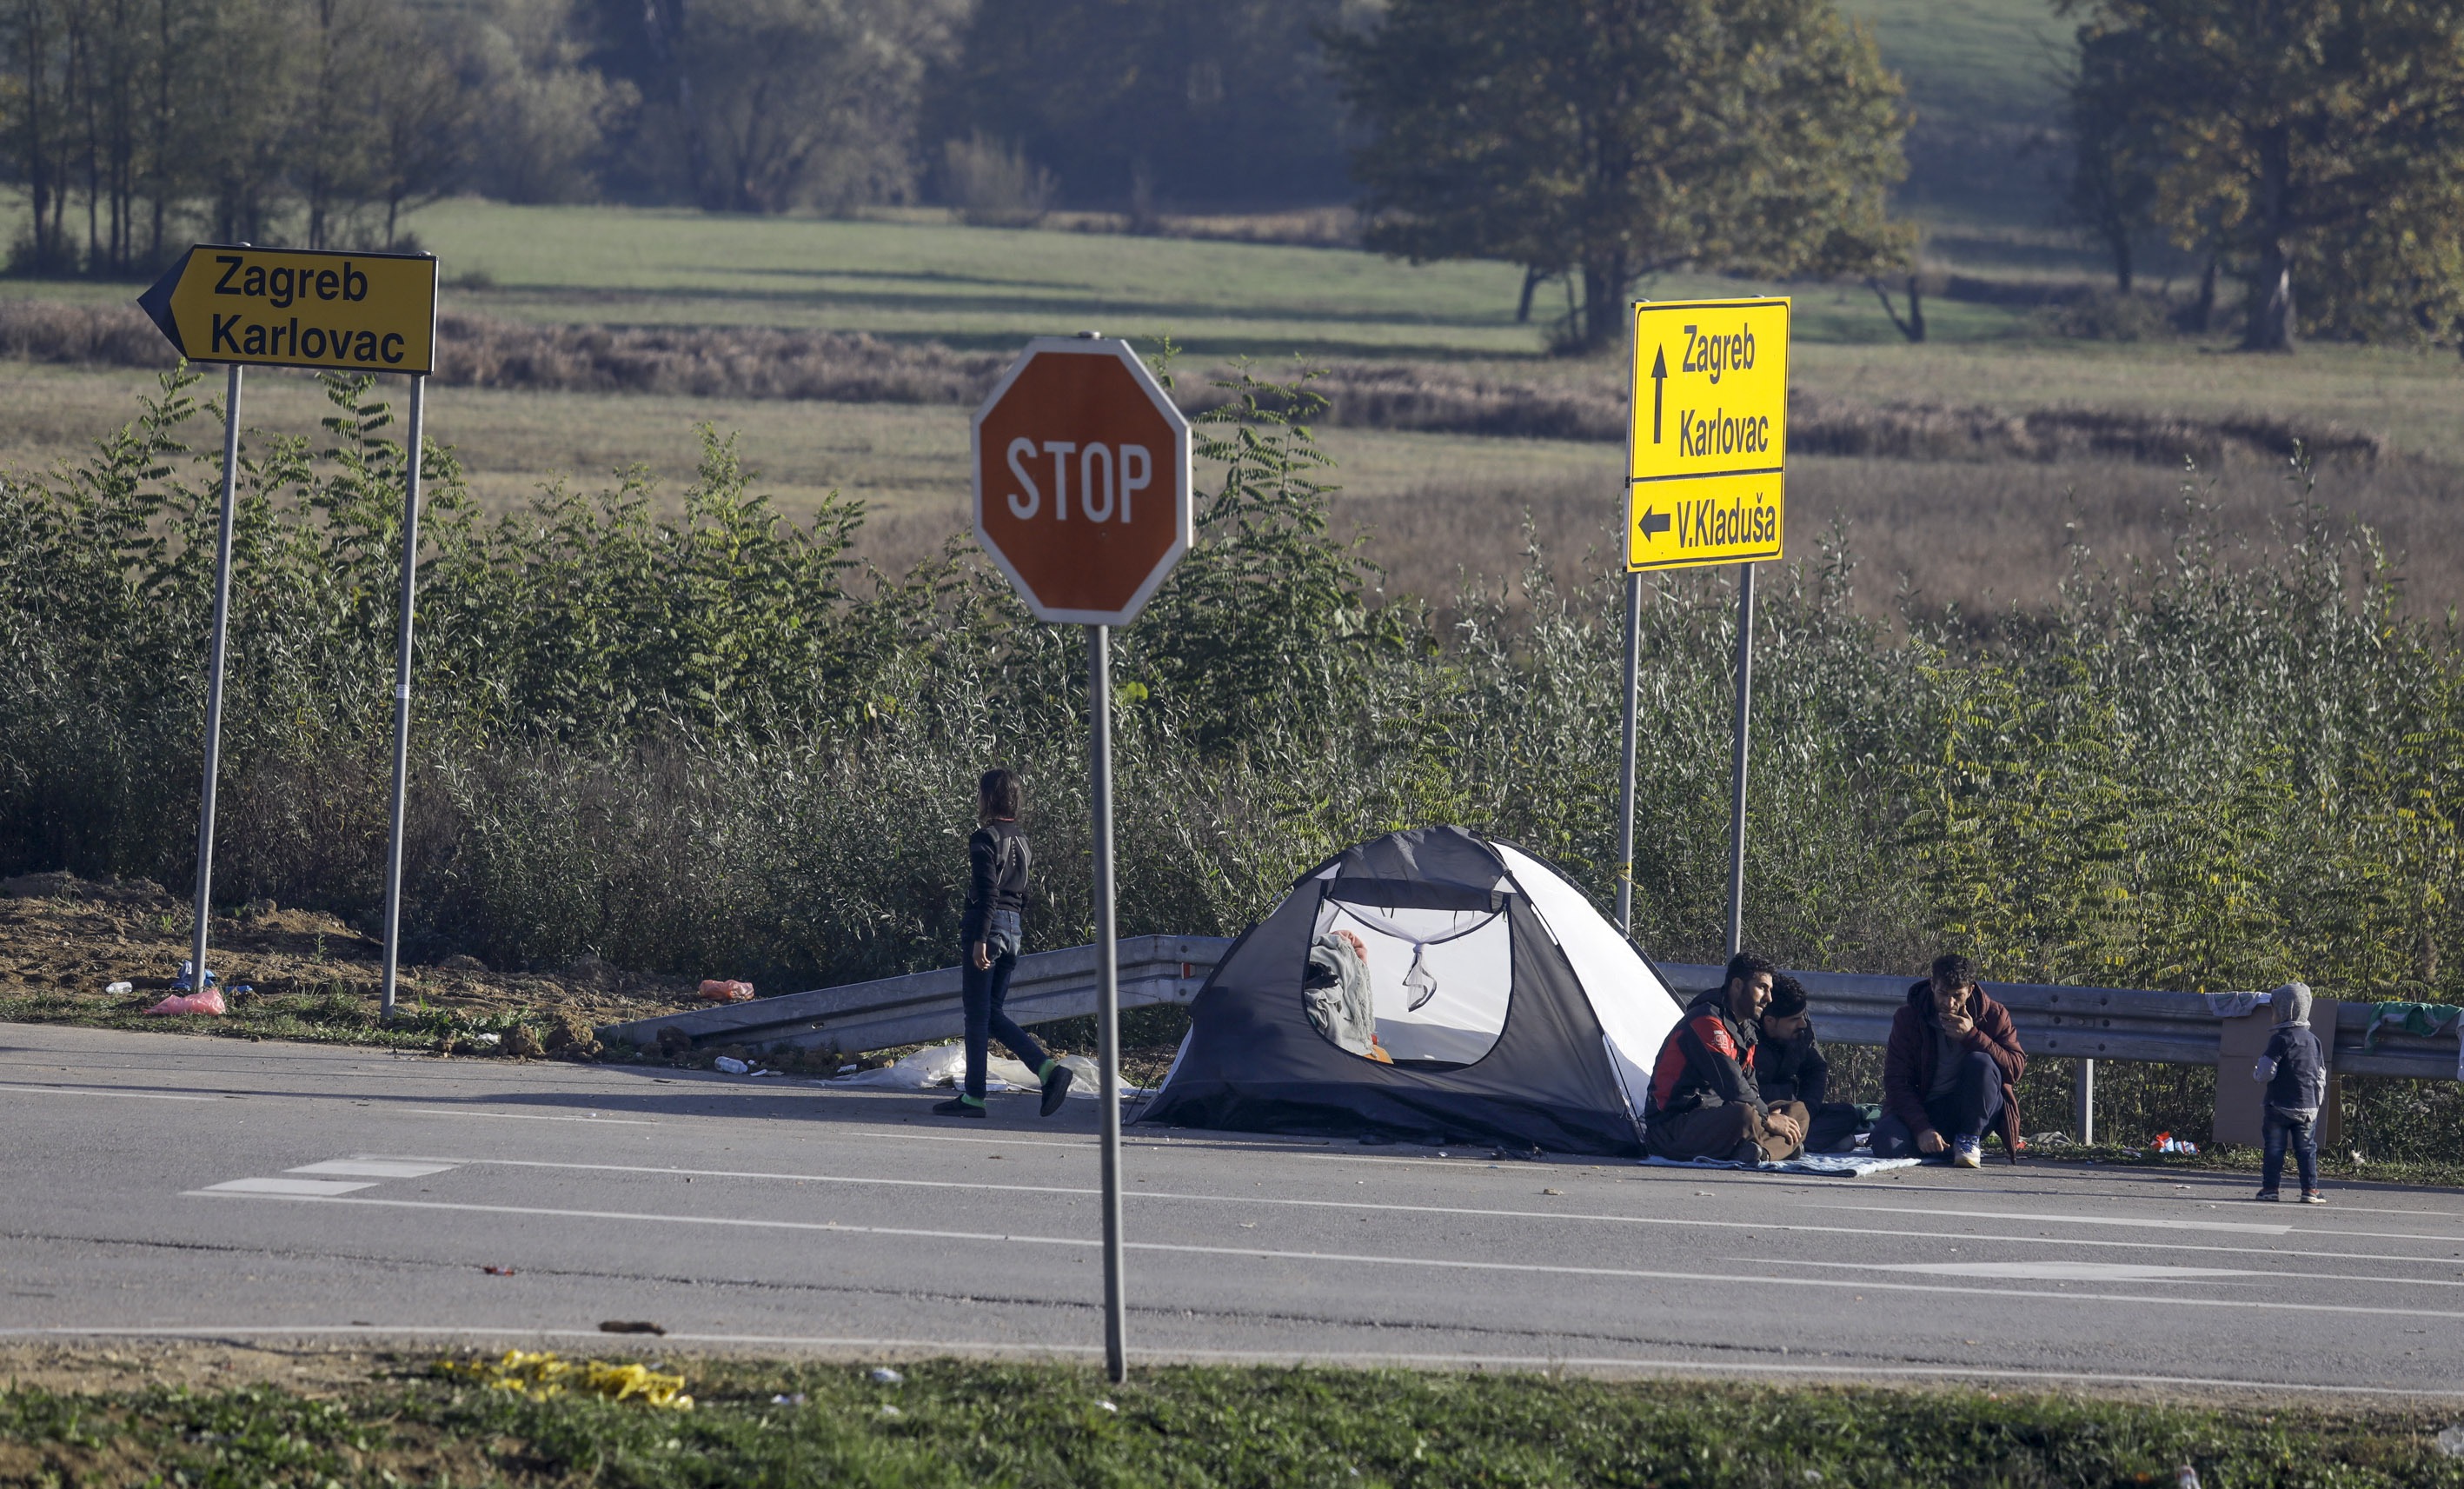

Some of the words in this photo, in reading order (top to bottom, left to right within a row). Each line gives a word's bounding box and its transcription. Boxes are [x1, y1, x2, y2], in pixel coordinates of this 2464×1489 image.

[214, 256, 368, 309] Zagreb
[211, 313, 405, 363] Karlovac
[1682, 322, 1756, 385] Zagreb
[1679, 407, 1769, 457] Karlovac
[1006, 436, 1152, 523] STOP
[1677, 491, 1776, 548] V.Kladuša
